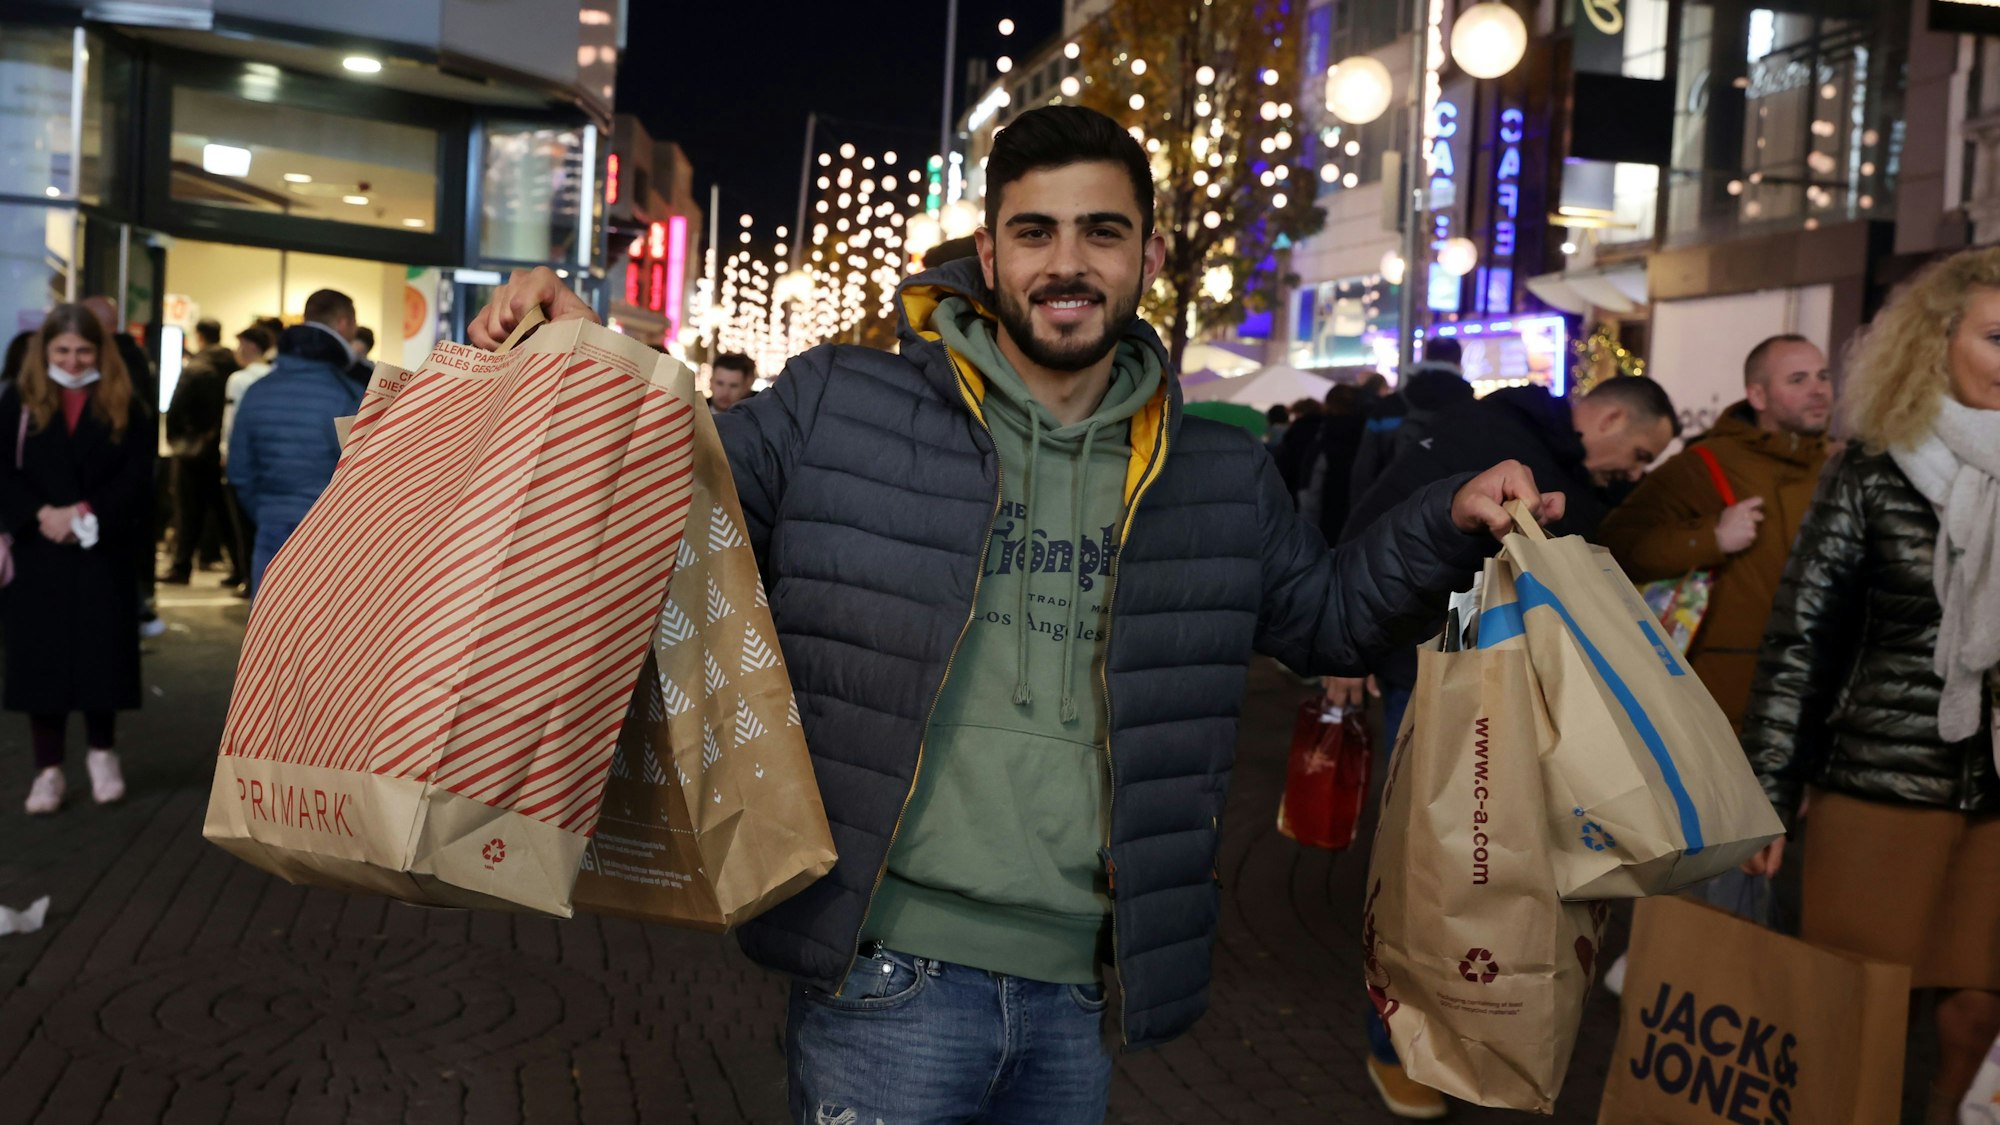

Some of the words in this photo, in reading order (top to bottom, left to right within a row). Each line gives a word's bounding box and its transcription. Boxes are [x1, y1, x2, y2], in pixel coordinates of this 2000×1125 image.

[430, 353, 471, 371] TOLLES
[1027, 593, 1072, 608] TRAD
[1473, 717, 1489, 885] www.c-a.com
[1629, 1032, 1793, 1125] JONES
